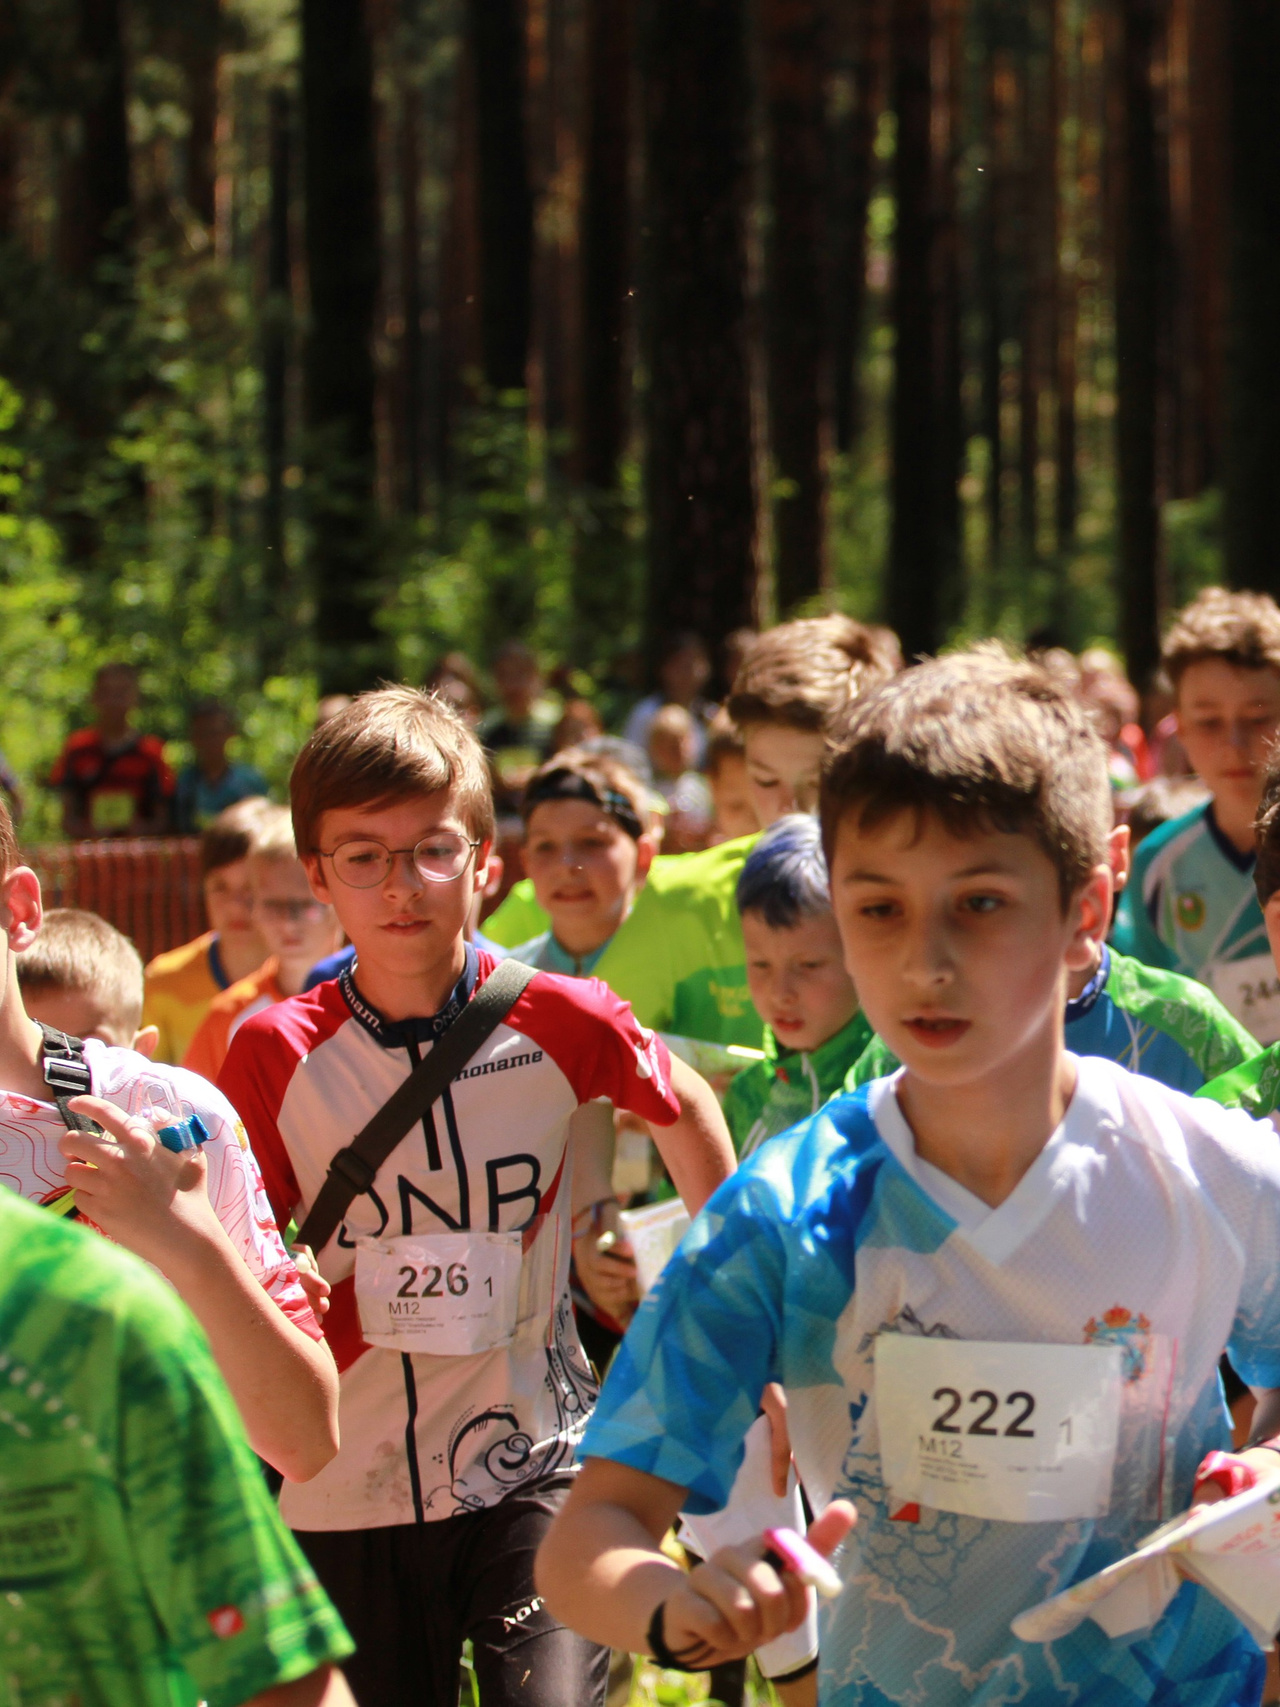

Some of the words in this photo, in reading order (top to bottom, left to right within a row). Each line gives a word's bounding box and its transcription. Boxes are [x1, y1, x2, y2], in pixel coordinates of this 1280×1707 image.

[454, 1049, 543, 1082] noname
[396, 1262, 470, 1298] 226
[483, 1275, 494, 1298] 1
[388, 1301, 421, 1315] M12
[931, 1387, 1036, 1438] 222
[1059, 1416, 1073, 1446] 1
[919, 1435, 963, 1459] M12
